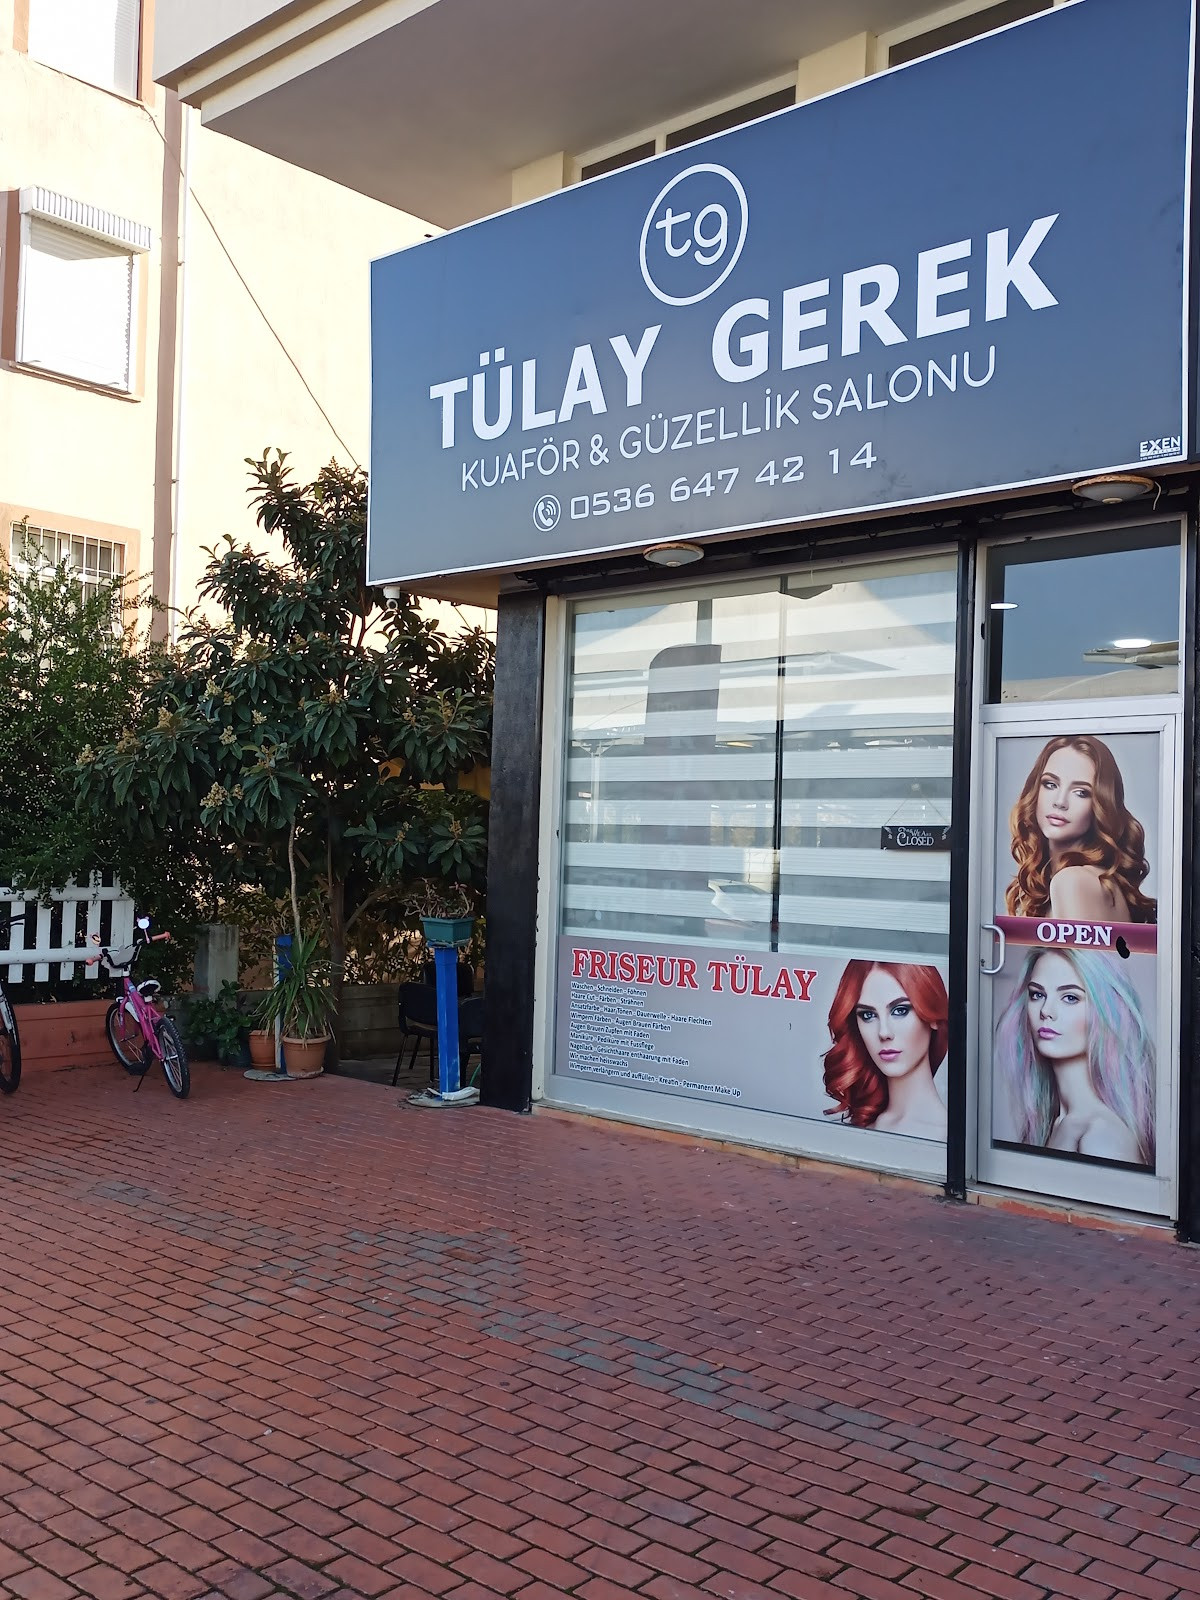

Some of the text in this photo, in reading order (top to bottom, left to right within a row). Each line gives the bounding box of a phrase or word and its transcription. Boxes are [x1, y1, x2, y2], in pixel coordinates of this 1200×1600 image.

[655, 203, 728, 266] tg
[430, 213, 1060, 449] TÜLAY GEREK
[461, 345, 996, 492] KUAFÖR & GÜZELLİK SALONU
[1140, 436, 1180, 453] EXEN
[570, 441, 877, 520] 0536 647 42 14
[897, 832, 934, 847] CLOSED
[1037, 922, 1112, 946] OPEN
[572, 948, 818, 1002] FRISEUR TÜLAY
[571, 982, 594, 990] Waschen
[571, 991, 586, 1000] Haare
[671, 1014, 687, 1022] Haare
[688, 1016, 712, 1026] Flechten
[714, 1085, 731, 1095] Make
[731, 1088, 741, 1097] Up
